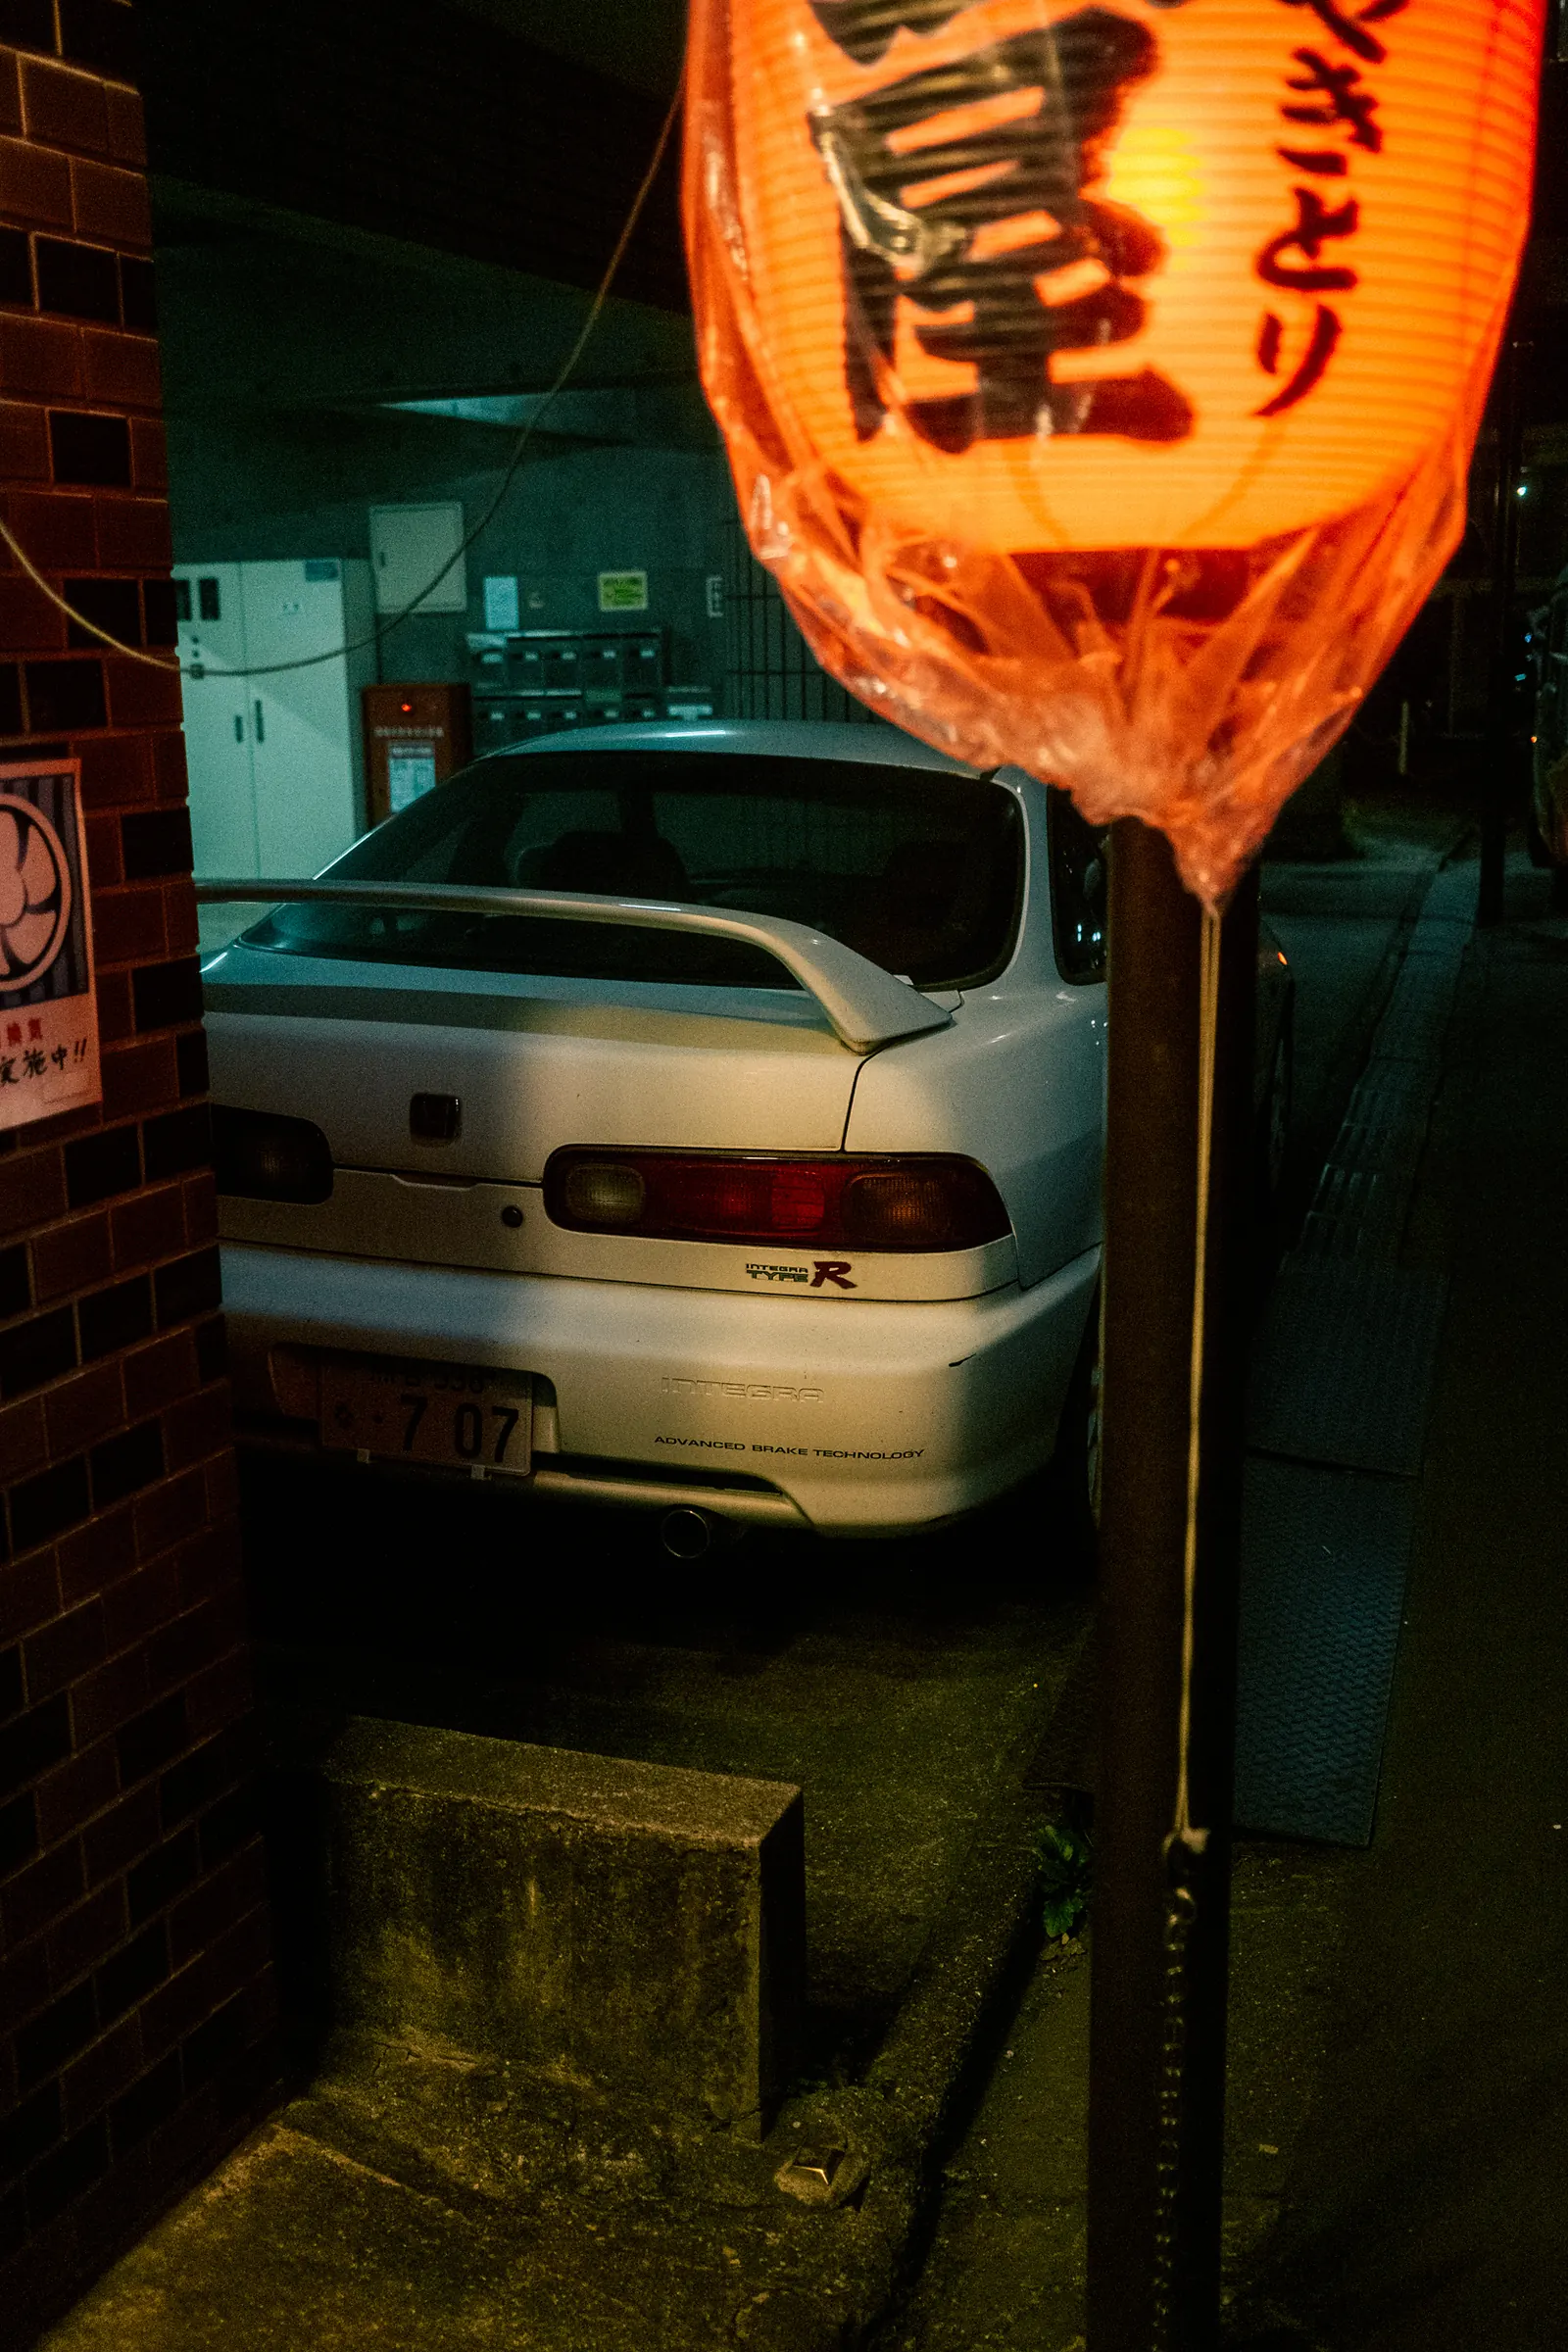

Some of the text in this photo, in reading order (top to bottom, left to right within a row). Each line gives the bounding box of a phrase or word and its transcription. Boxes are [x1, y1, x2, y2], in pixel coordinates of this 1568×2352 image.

[746, 1262, 808, 1273] INTEGRA
[746, 1260, 858, 1290] TYPE R
[661, 1376, 825, 1403] INTEGRA
[654, 1435, 926, 1460] ADVANCED BRAKE TECHNOLOGY
